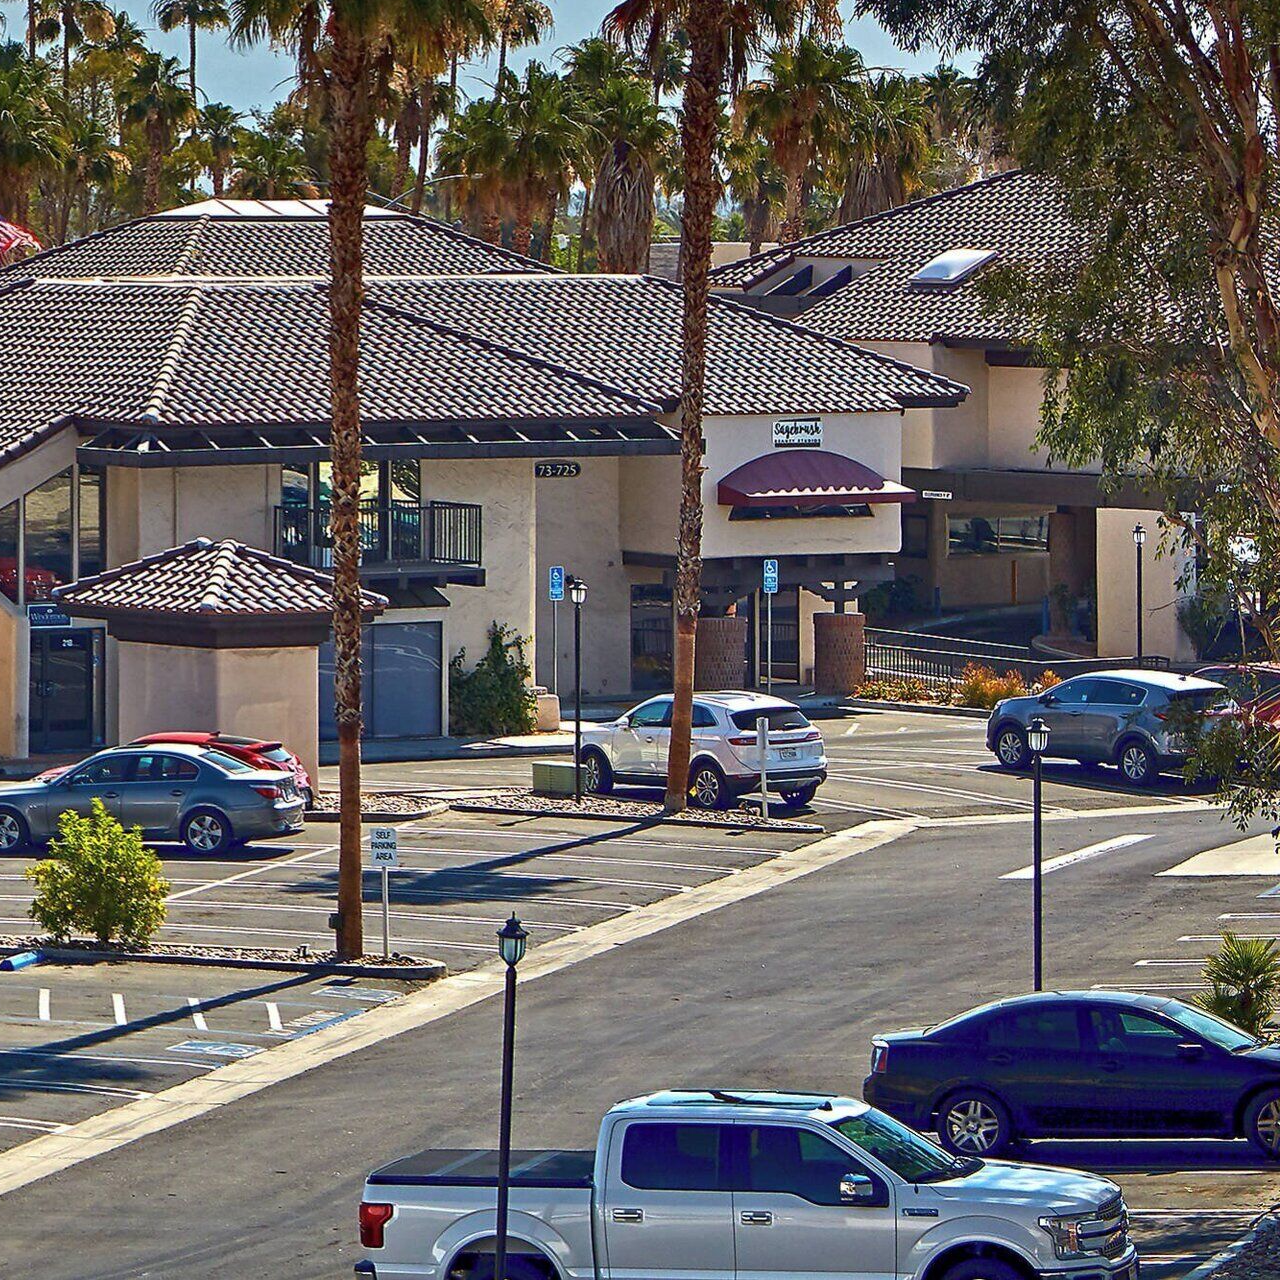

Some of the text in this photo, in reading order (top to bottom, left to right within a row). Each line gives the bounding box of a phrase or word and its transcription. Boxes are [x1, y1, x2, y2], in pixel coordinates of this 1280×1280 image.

[774, 422, 821, 439] Sagebrush
[538, 464, 577, 477] 73-725
[375, 831, 391, 840] SELF
[370, 841, 397, 850] PARKING
[375, 852, 394, 861] AREA
